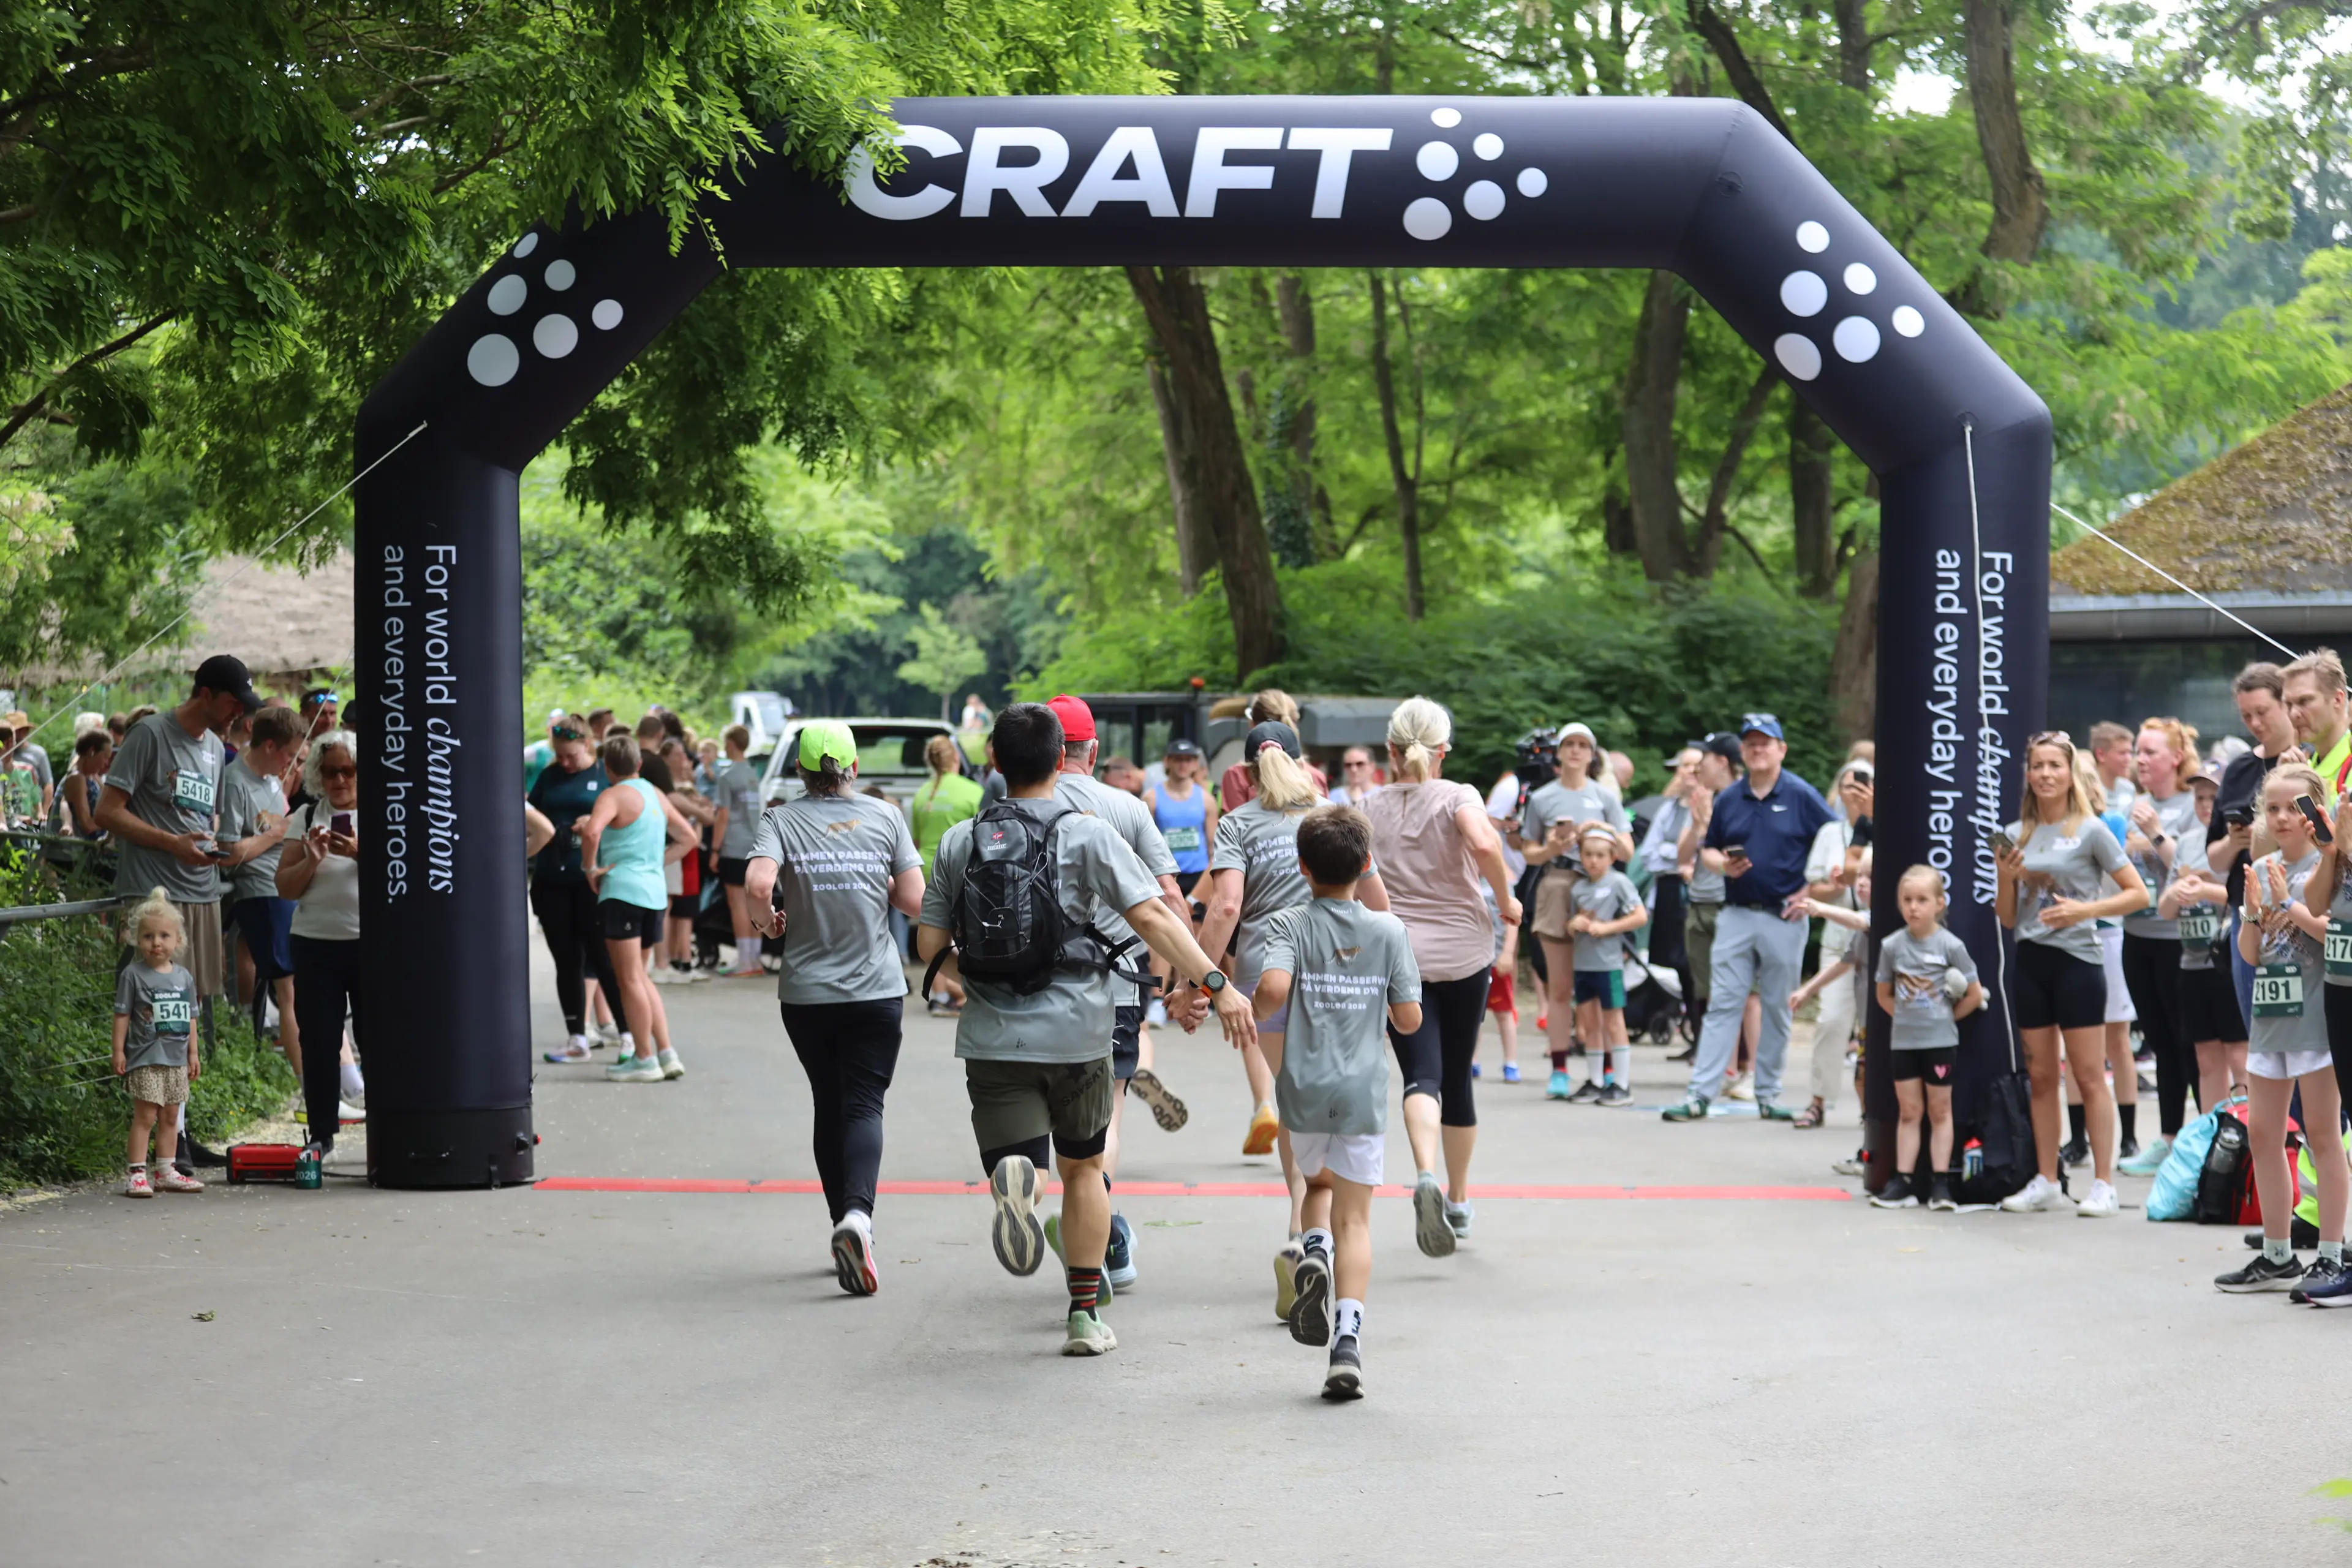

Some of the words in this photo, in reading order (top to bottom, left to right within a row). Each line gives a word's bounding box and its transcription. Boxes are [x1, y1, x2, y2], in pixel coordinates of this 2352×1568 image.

[843, 124, 1394, 221] CRAFT
[384, 545, 412, 607] and
[424, 545, 456, 601] For
[1935, 548, 1968, 614] and
[1980, 551, 2013, 610] For
[424, 608, 457, 704] world
[1978, 616, 2010, 715] world
[380, 617, 412, 772] everyday
[1924, 622, 1964, 783] everyday
[181, 779, 211, 803] 5418
[420, 717, 461, 894] champions
[386, 782, 413, 904] heroes.
[810, 862, 864, 873] VERDENS
[866, 864, 885, 874] DYR
[1927, 790, 1963, 907] hero
[1298, 971, 1337, 984] AMMEN
[2326, 936, 2352, 960] 217
[1314, 984, 1361, 995] VERDENS
[2255, 980, 2291, 1001] 2191
